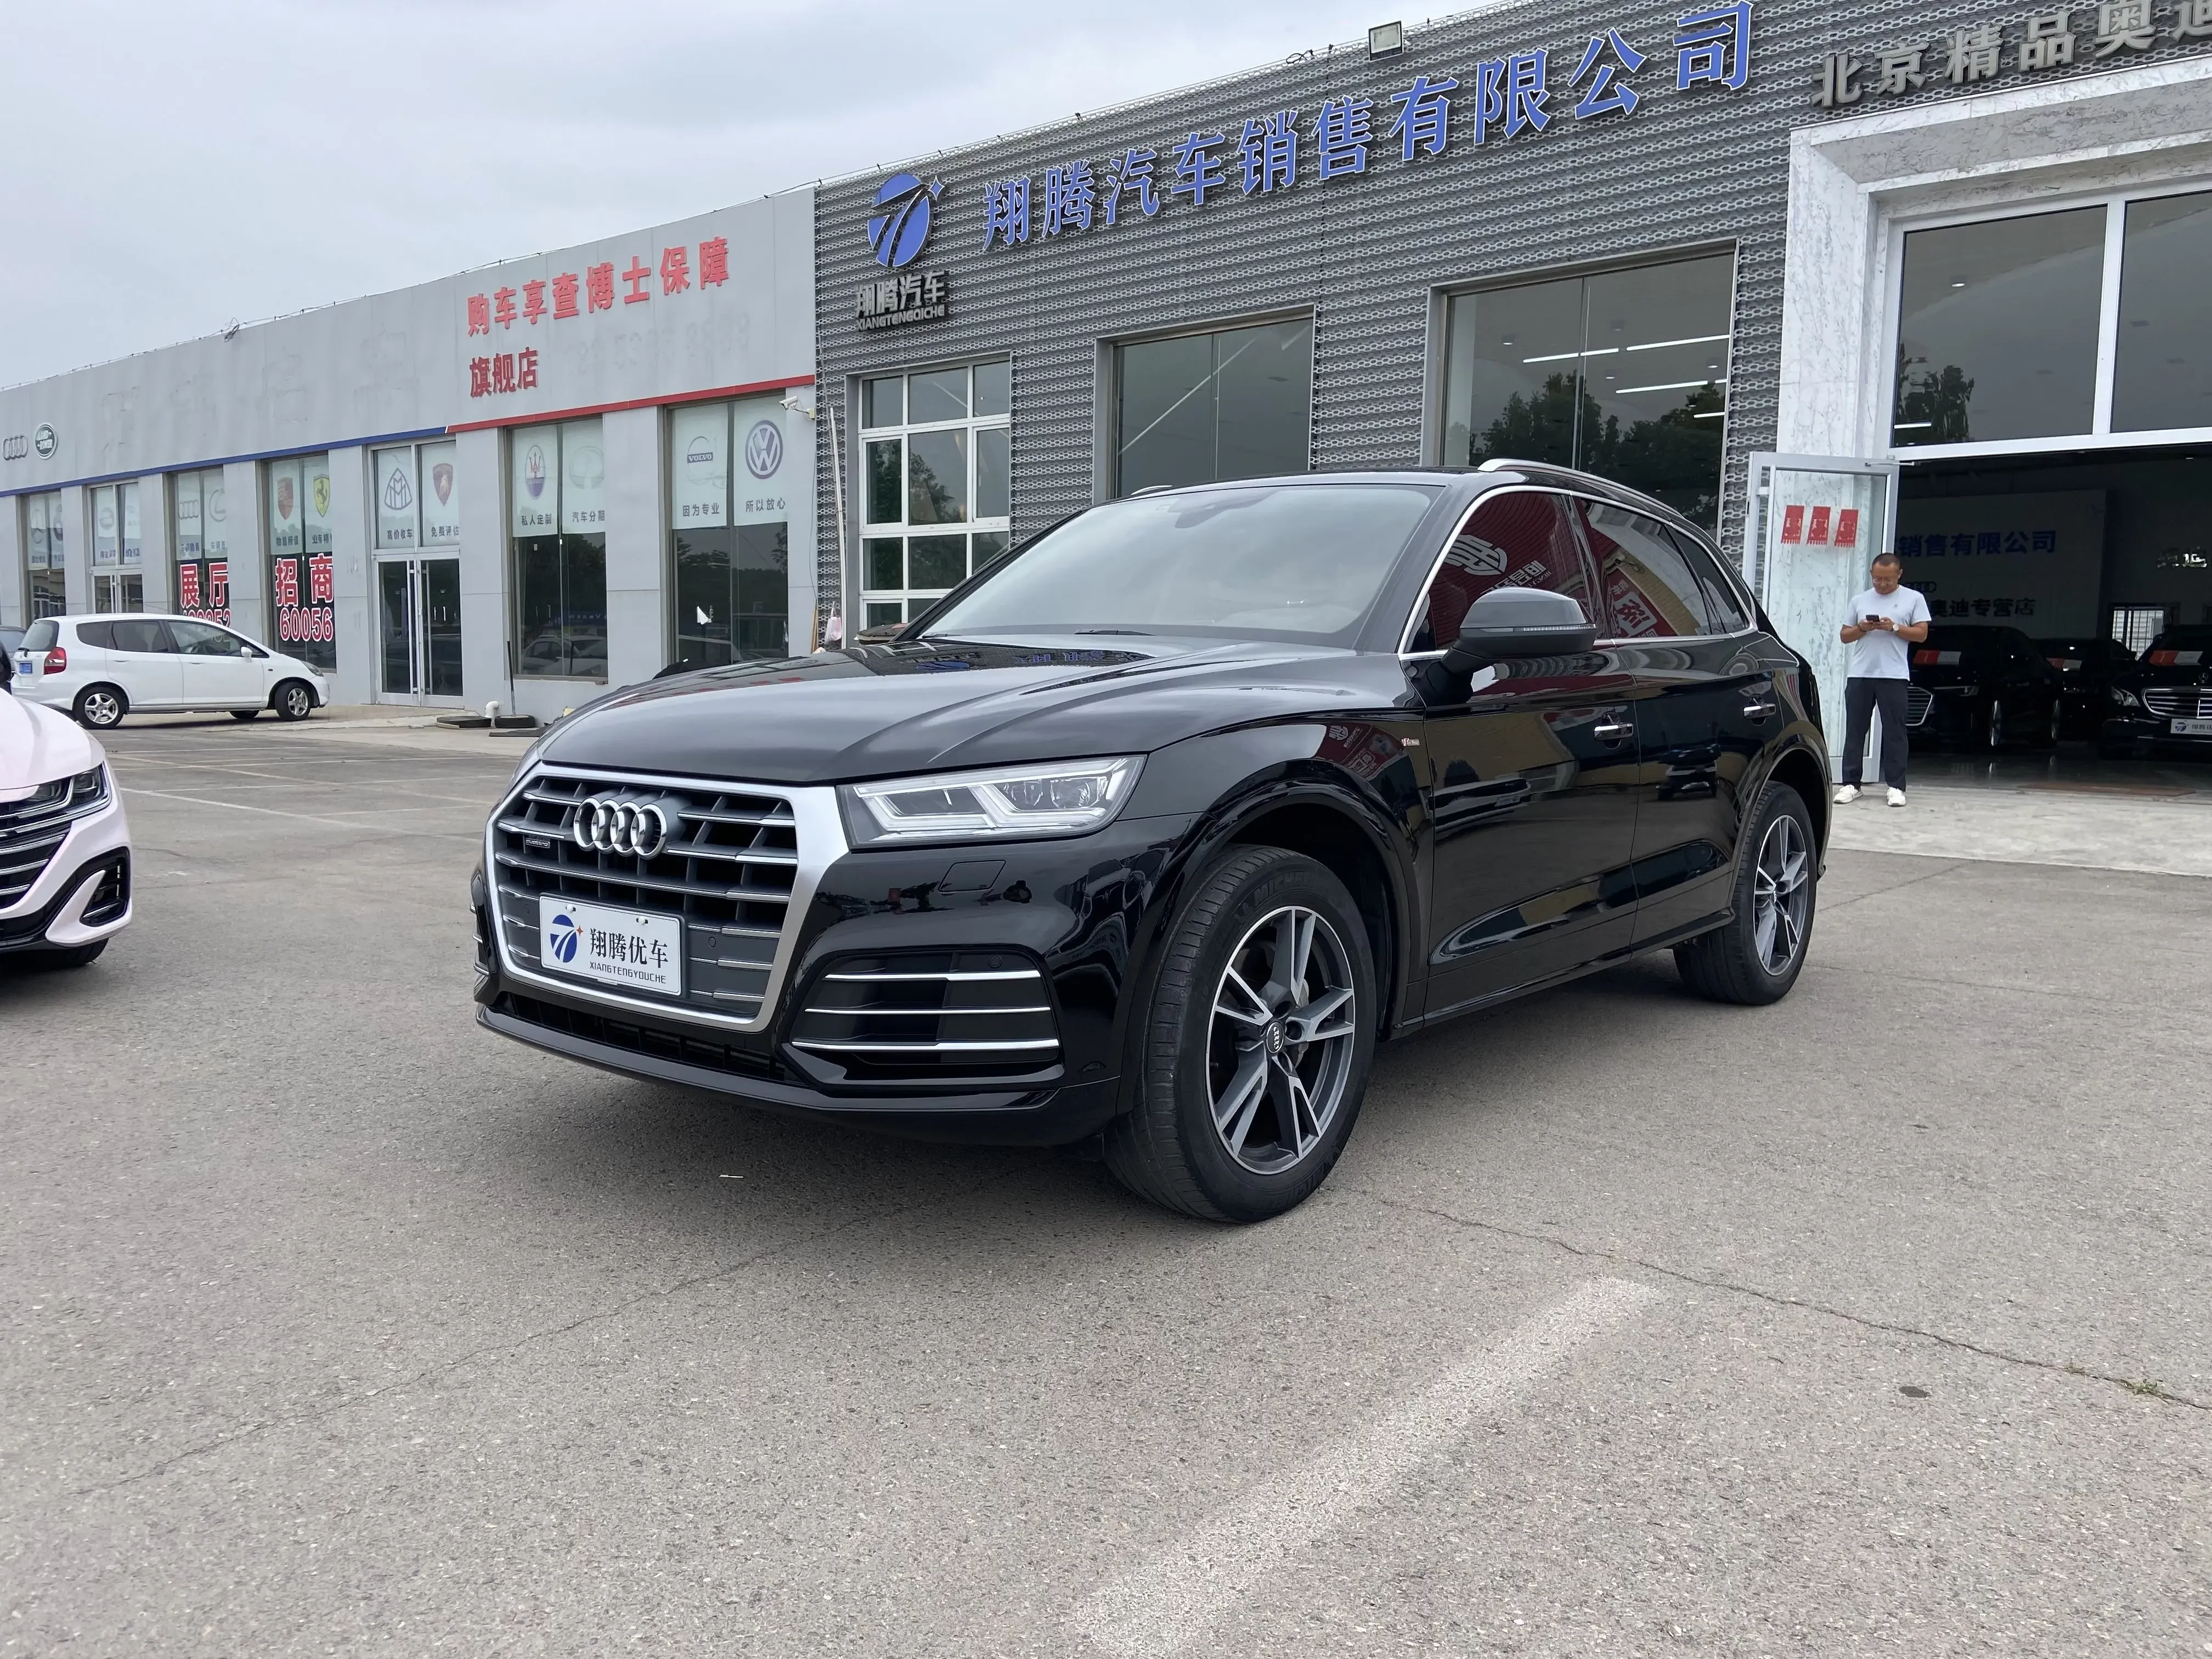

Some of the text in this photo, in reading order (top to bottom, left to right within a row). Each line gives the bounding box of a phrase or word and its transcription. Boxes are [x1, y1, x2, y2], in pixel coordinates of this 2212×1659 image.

[983, 0, 1754, 251] 翔腾汽车销售有限公司
[467, 236, 730, 338] 购车享查博士保障
[855, 270, 946, 318] 翔腾汽车
[469, 346, 539, 398] 旗舰店
[688, 454, 712, 462] VOLVO
[521, 513, 552, 526] 私人定制
[572, 510, 605, 523] 汽车分期
[682, 502, 720, 517] 因为专业
[745, 498, 786, 513] 所以放心
[386, 528, 413, 540] 高价收车
[431, 525, 460, 538] 免费评估
[180, 562, 229, 609] 展厅
[275, 553, 334, 607] 招商
[279, 607, 334, 642] 60056
[590, 928, 668, 968] 翔腾优车
